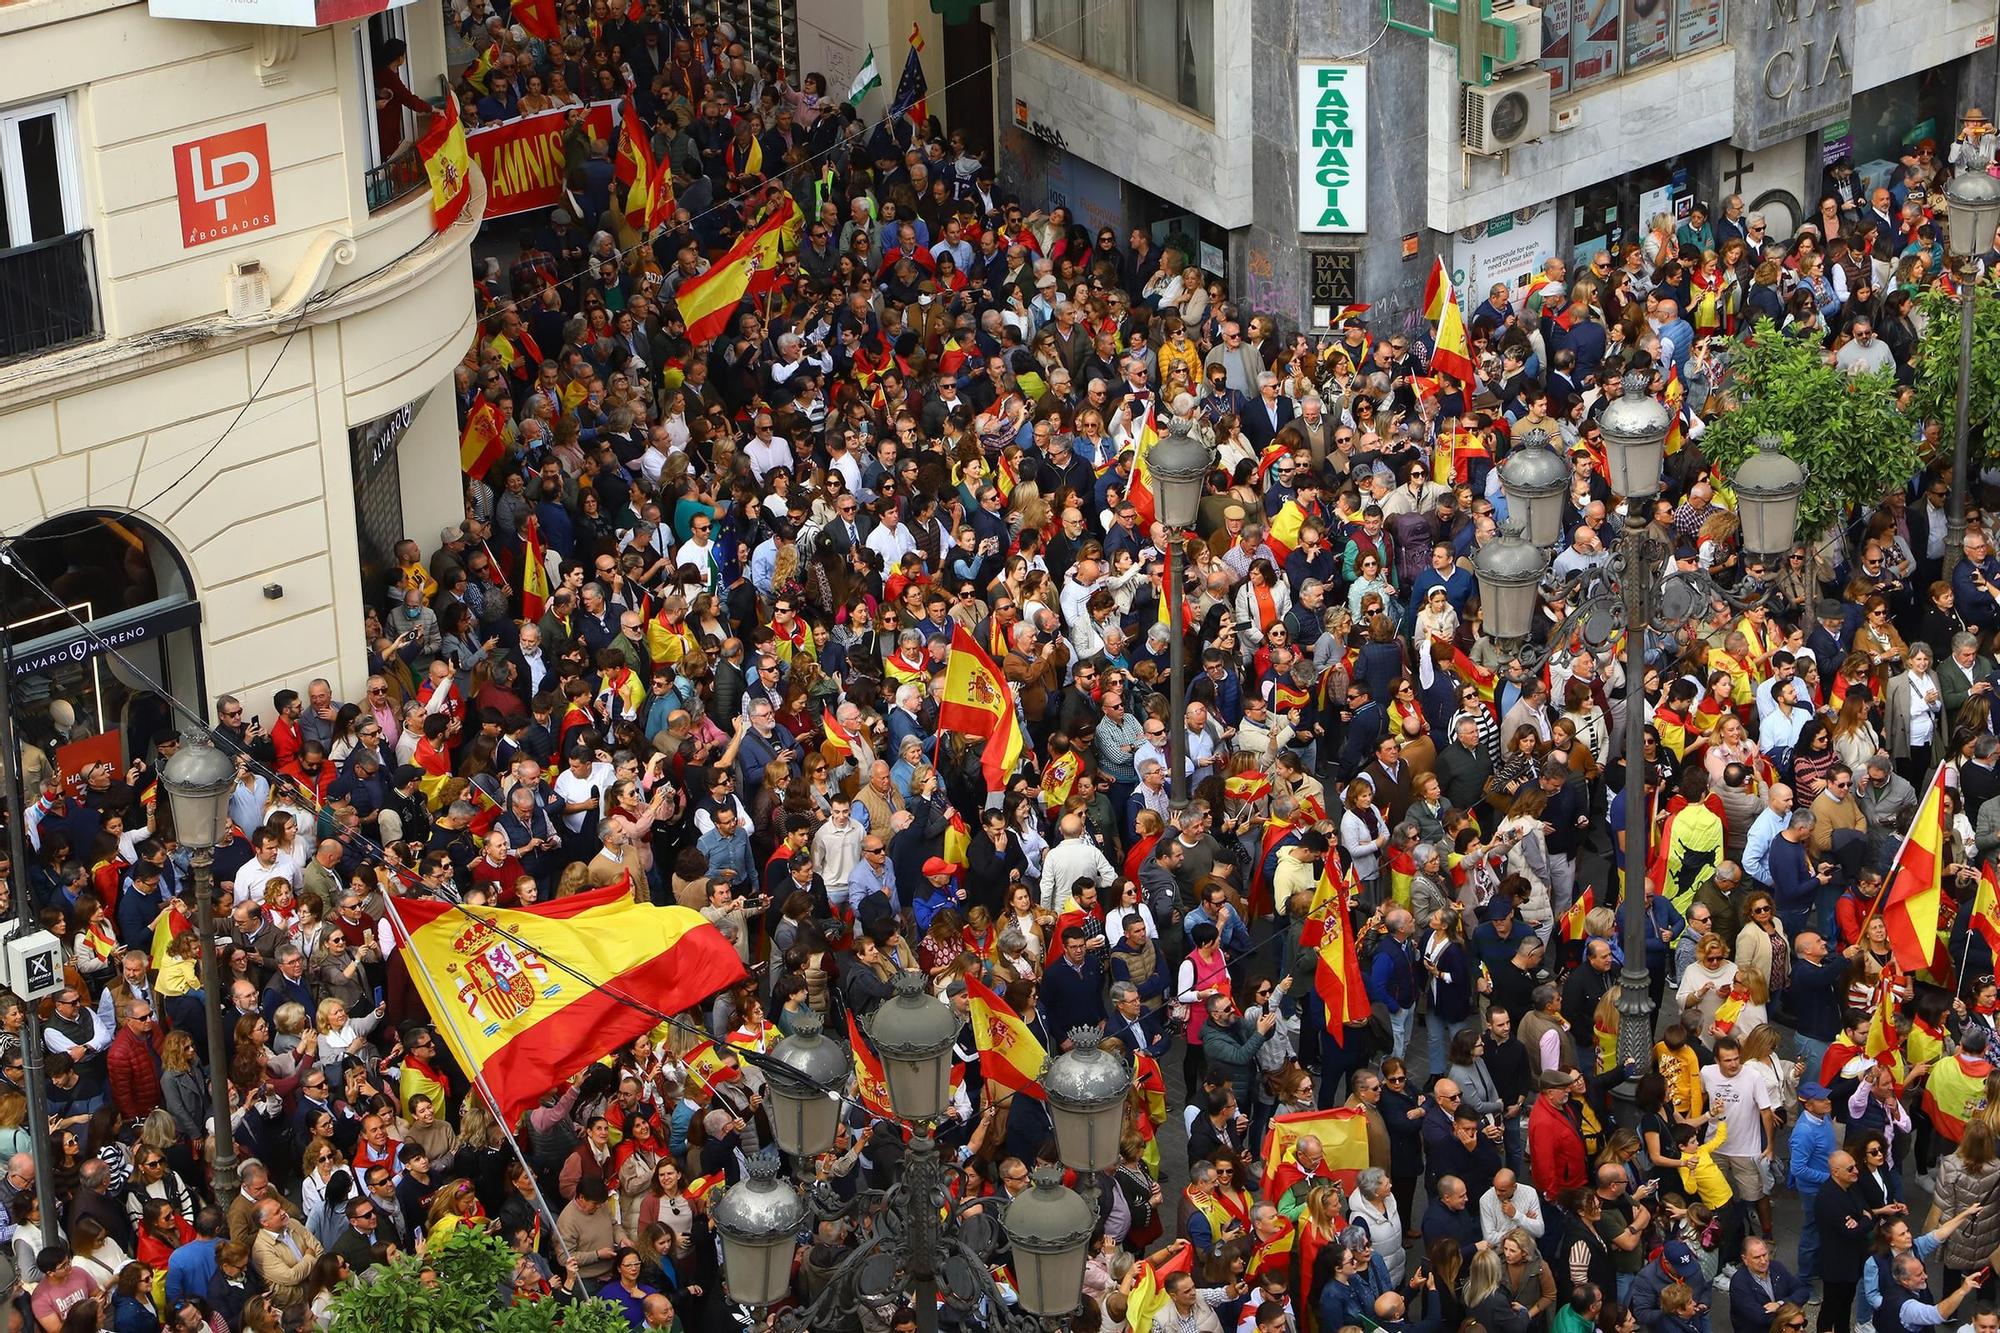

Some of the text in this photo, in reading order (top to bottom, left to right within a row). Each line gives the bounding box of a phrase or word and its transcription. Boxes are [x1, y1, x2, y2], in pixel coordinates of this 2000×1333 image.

[1762, 32, 1851, 100] CIA
[1312, 69, 1353, 227] FARMACIA
[189, 214, 271, 244] ABOGADOS
[1316, 255, 1351, 269] FAR
[1492, 249, 1516, 262] ampoule
[1509, 255, 1522, 265] your
[1317, 269, 1347, 284] MA
[1316, 283, 1352, 299] CIA
[373, 413, 401, 467] ALVARO
[16, 650, 68, 675] ALVARO
[90, 626, 145, 652] MORENO
